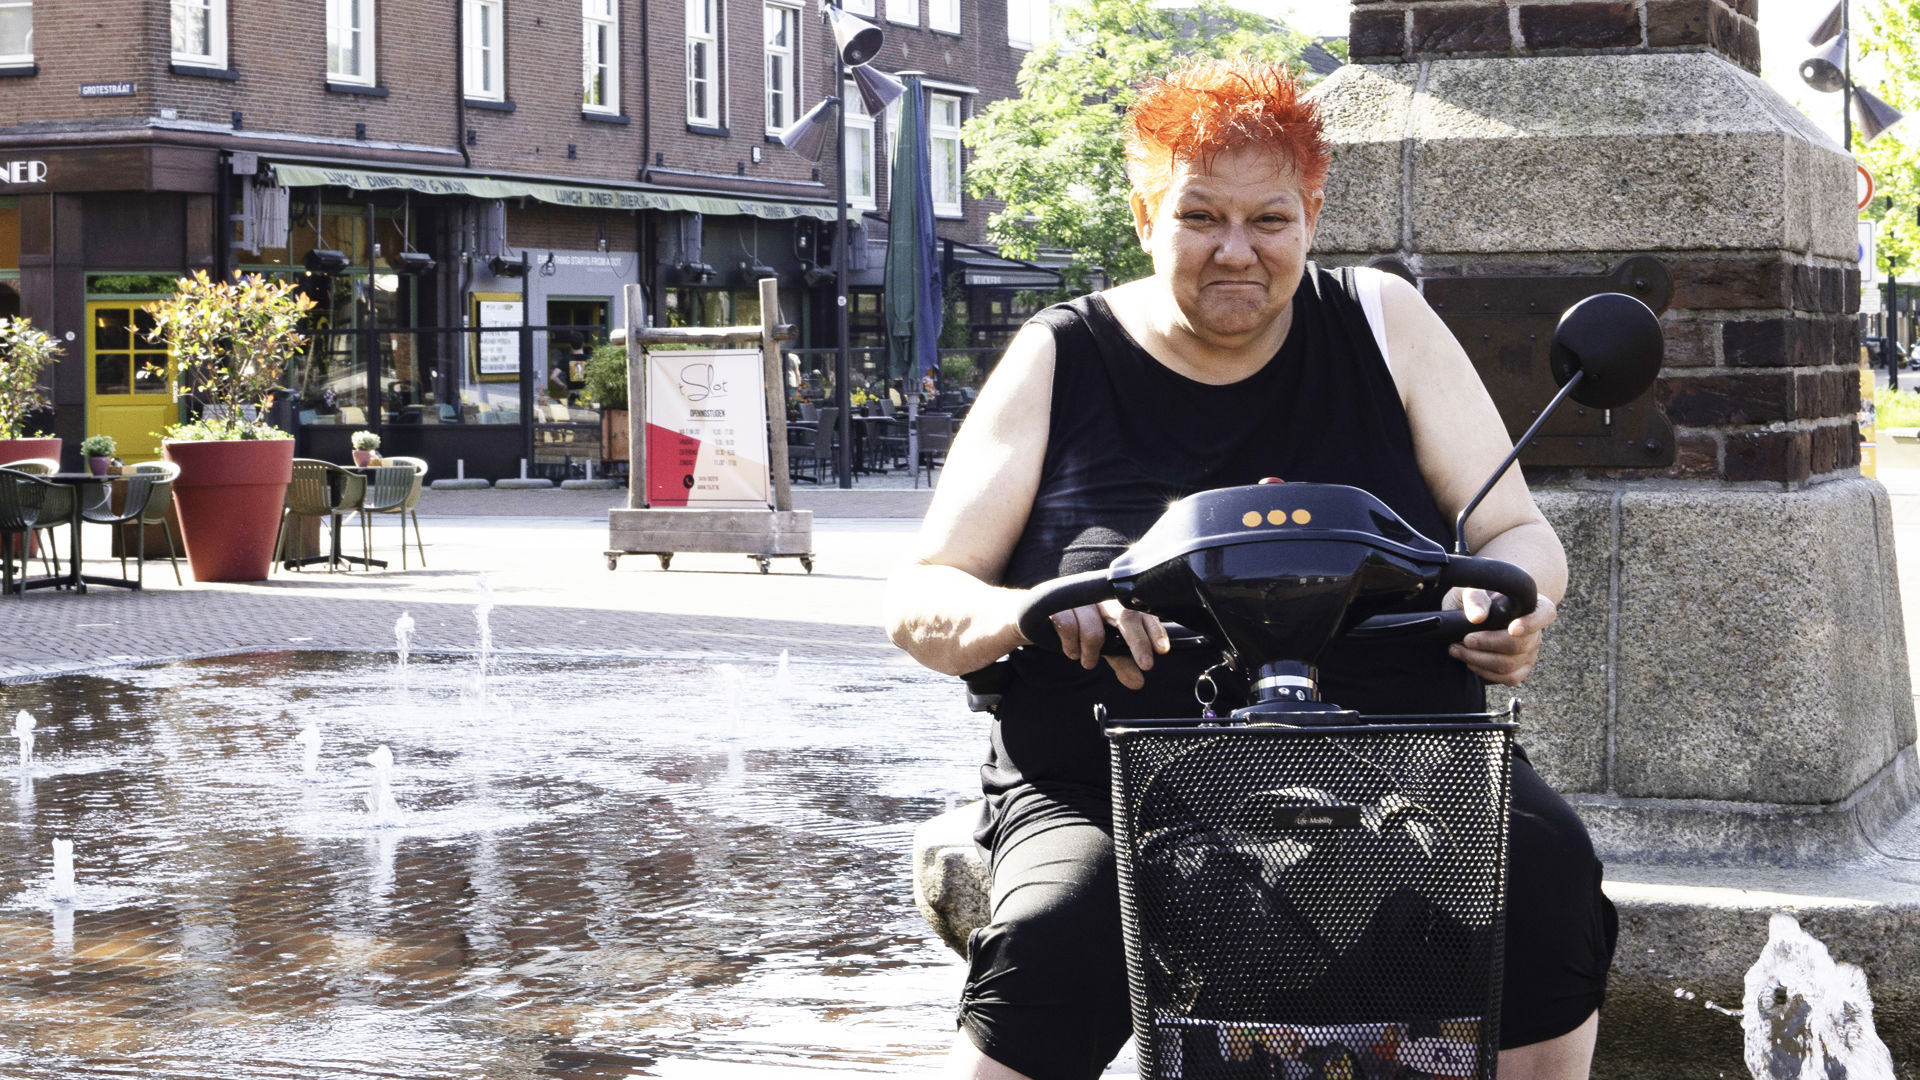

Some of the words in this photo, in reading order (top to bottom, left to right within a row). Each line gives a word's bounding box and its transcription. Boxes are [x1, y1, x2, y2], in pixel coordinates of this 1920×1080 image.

[82, 84, 130, 95] GROTESTRAAT
[323, 171, 361, 188] LUNCH
[366, 175, 403, 189] DINER
[554, 189, 583, 204] LUNCH
[588, 192, 614, 206] DINER
[620, 193, 641, 207] BIER
[763, 206, 787, 218] DINER
[570, 256, 591, 266] STARTS
[680, 363, 728, 402] Slot
